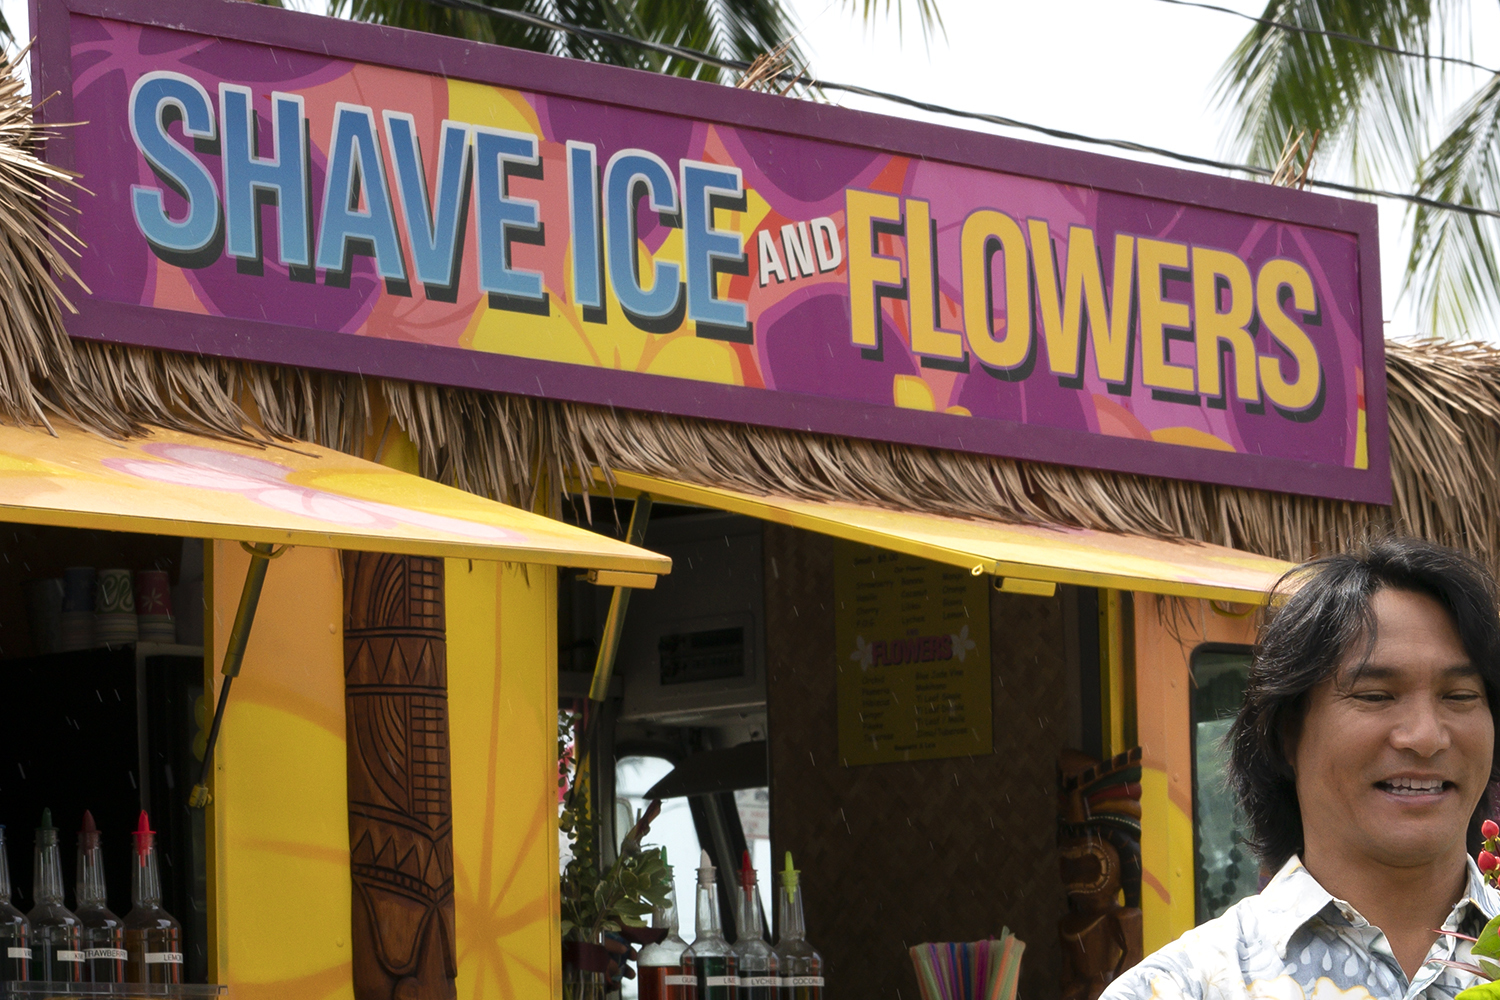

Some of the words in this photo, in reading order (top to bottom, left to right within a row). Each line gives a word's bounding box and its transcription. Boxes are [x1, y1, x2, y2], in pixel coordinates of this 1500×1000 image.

[128, 70, 549, 314] SHAVE
[566, 140, 753, 343] ICE
[757, 216, 843, 289] AND
[845, 187, 1325, 421] FLOWERS
[871, 634, 953, 667] FLOWERS
[84, 948, 126, 959] TRAWBERRY
[751, 978, 778, 986] LYCHEE
